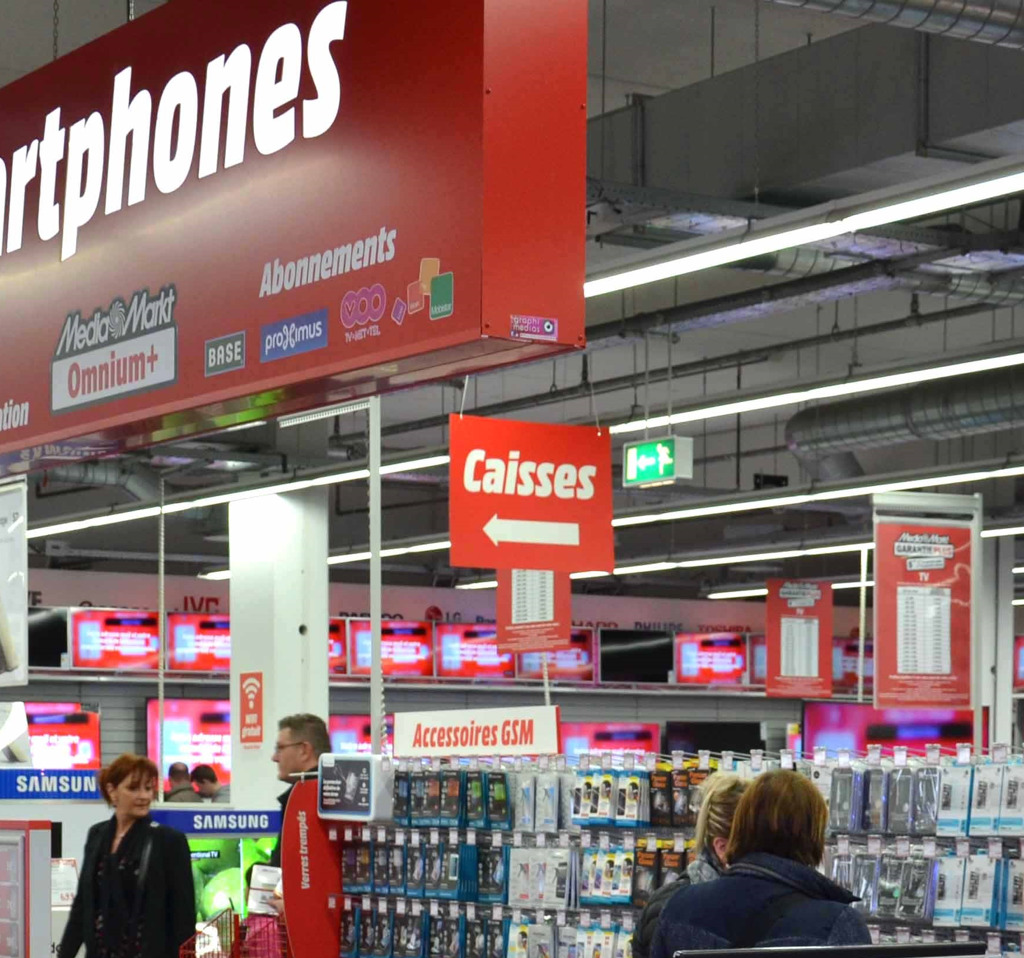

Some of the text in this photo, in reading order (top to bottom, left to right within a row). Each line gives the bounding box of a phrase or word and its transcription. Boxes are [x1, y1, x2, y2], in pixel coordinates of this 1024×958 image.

[259, 227, 396, 297] Abonnements
[56, 289, 175, 356] Media Markt
[68, 345, 158, 398] Omnium+
[209, 340, 242, 368] BASE
[463, 449, 597, 500] Caisses
[412, 719, 534, 748] Accessoires GSM
[16, 775, 97, 793] SAMSUN
[193, 814, 269, 829] SAMSUNG
[299, 811, 310, 889] Verres trempés
